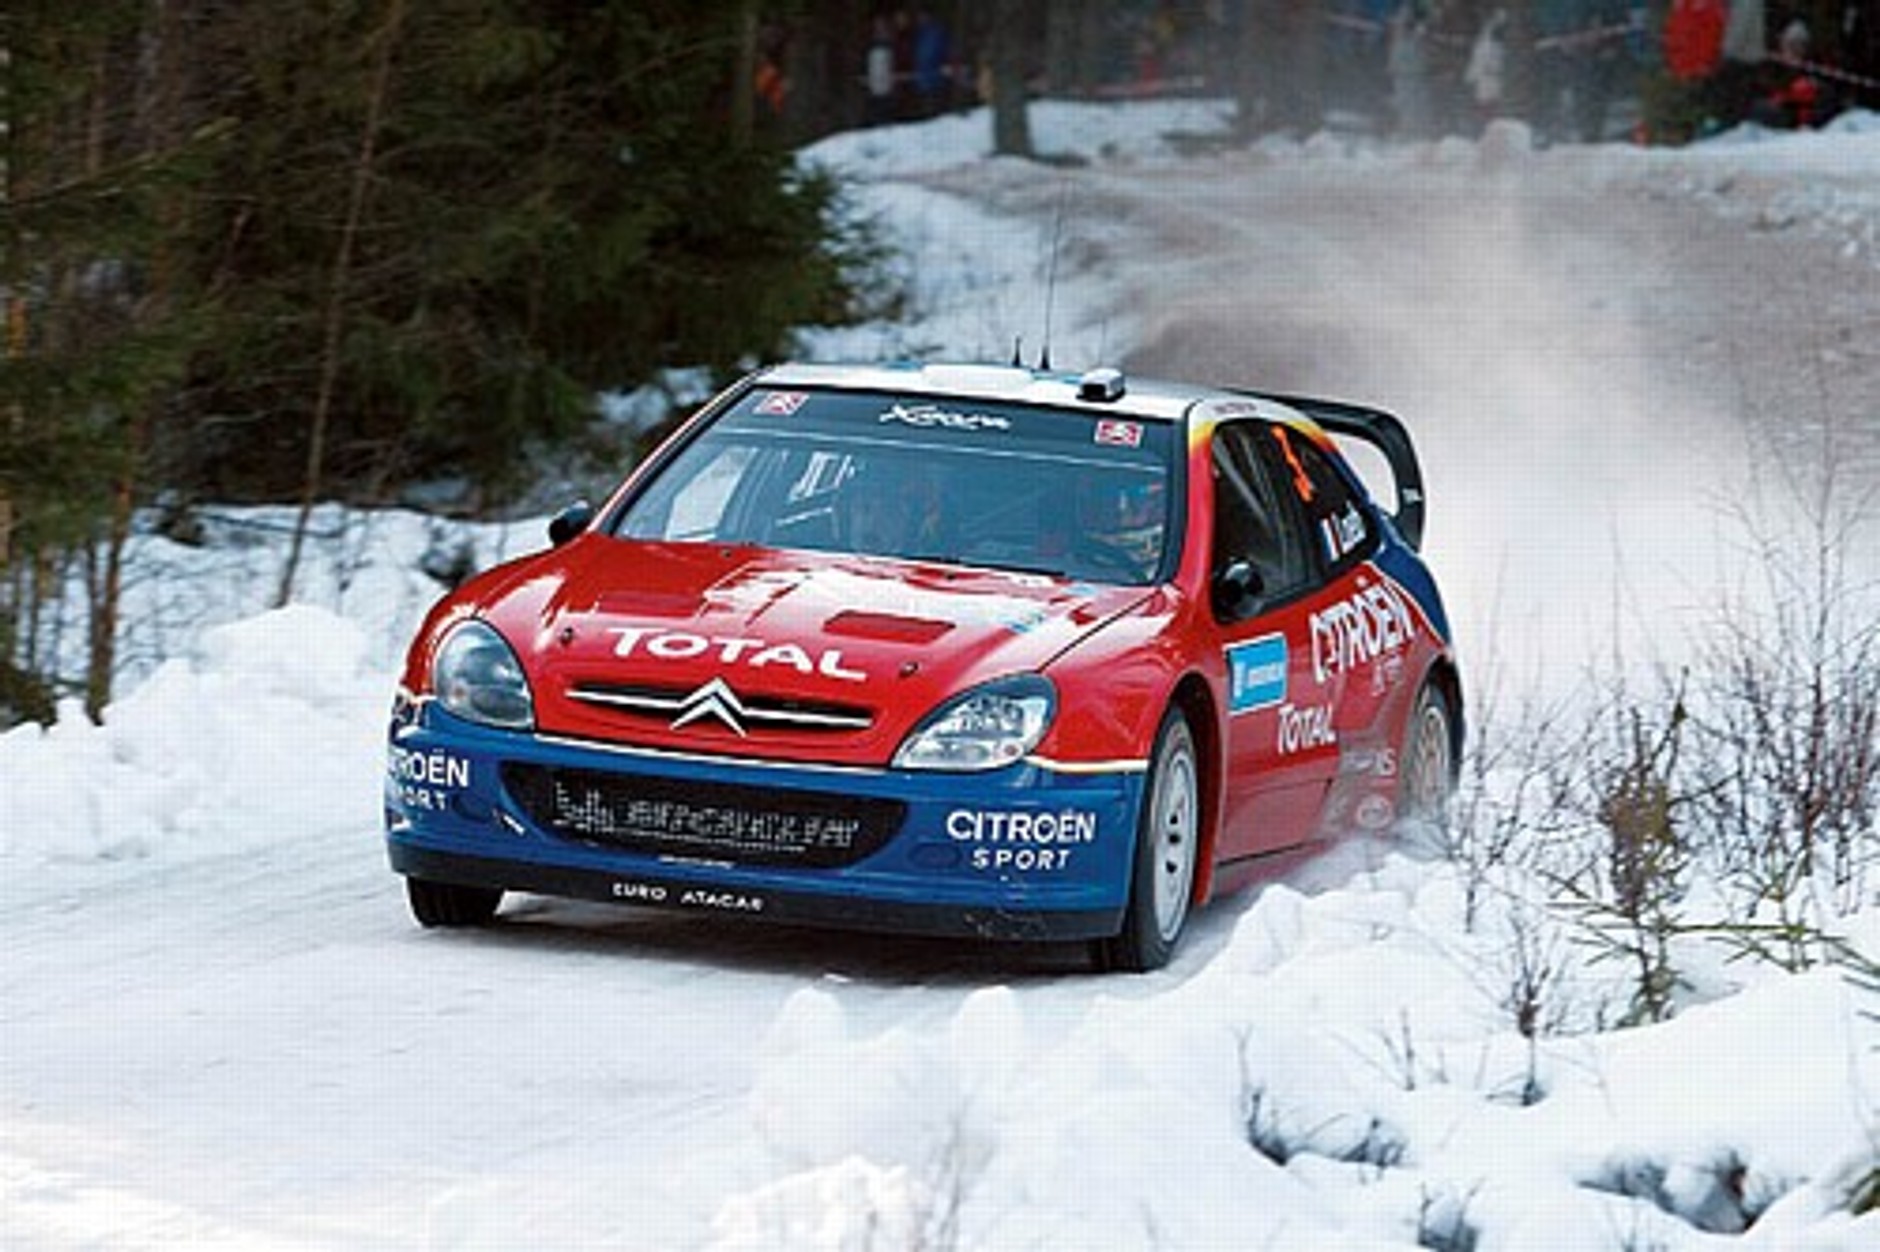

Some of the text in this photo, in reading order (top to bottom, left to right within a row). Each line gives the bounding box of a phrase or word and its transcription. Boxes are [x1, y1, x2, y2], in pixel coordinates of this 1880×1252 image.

[606, 627, 868, 681] TOTAL
[1278, 703, 1336, 754] TOTAL
[388, 748, 470, 788] ROËN
[972, 848, 1071, 870] SPORT
[612, 883, 667, 900] EURO
